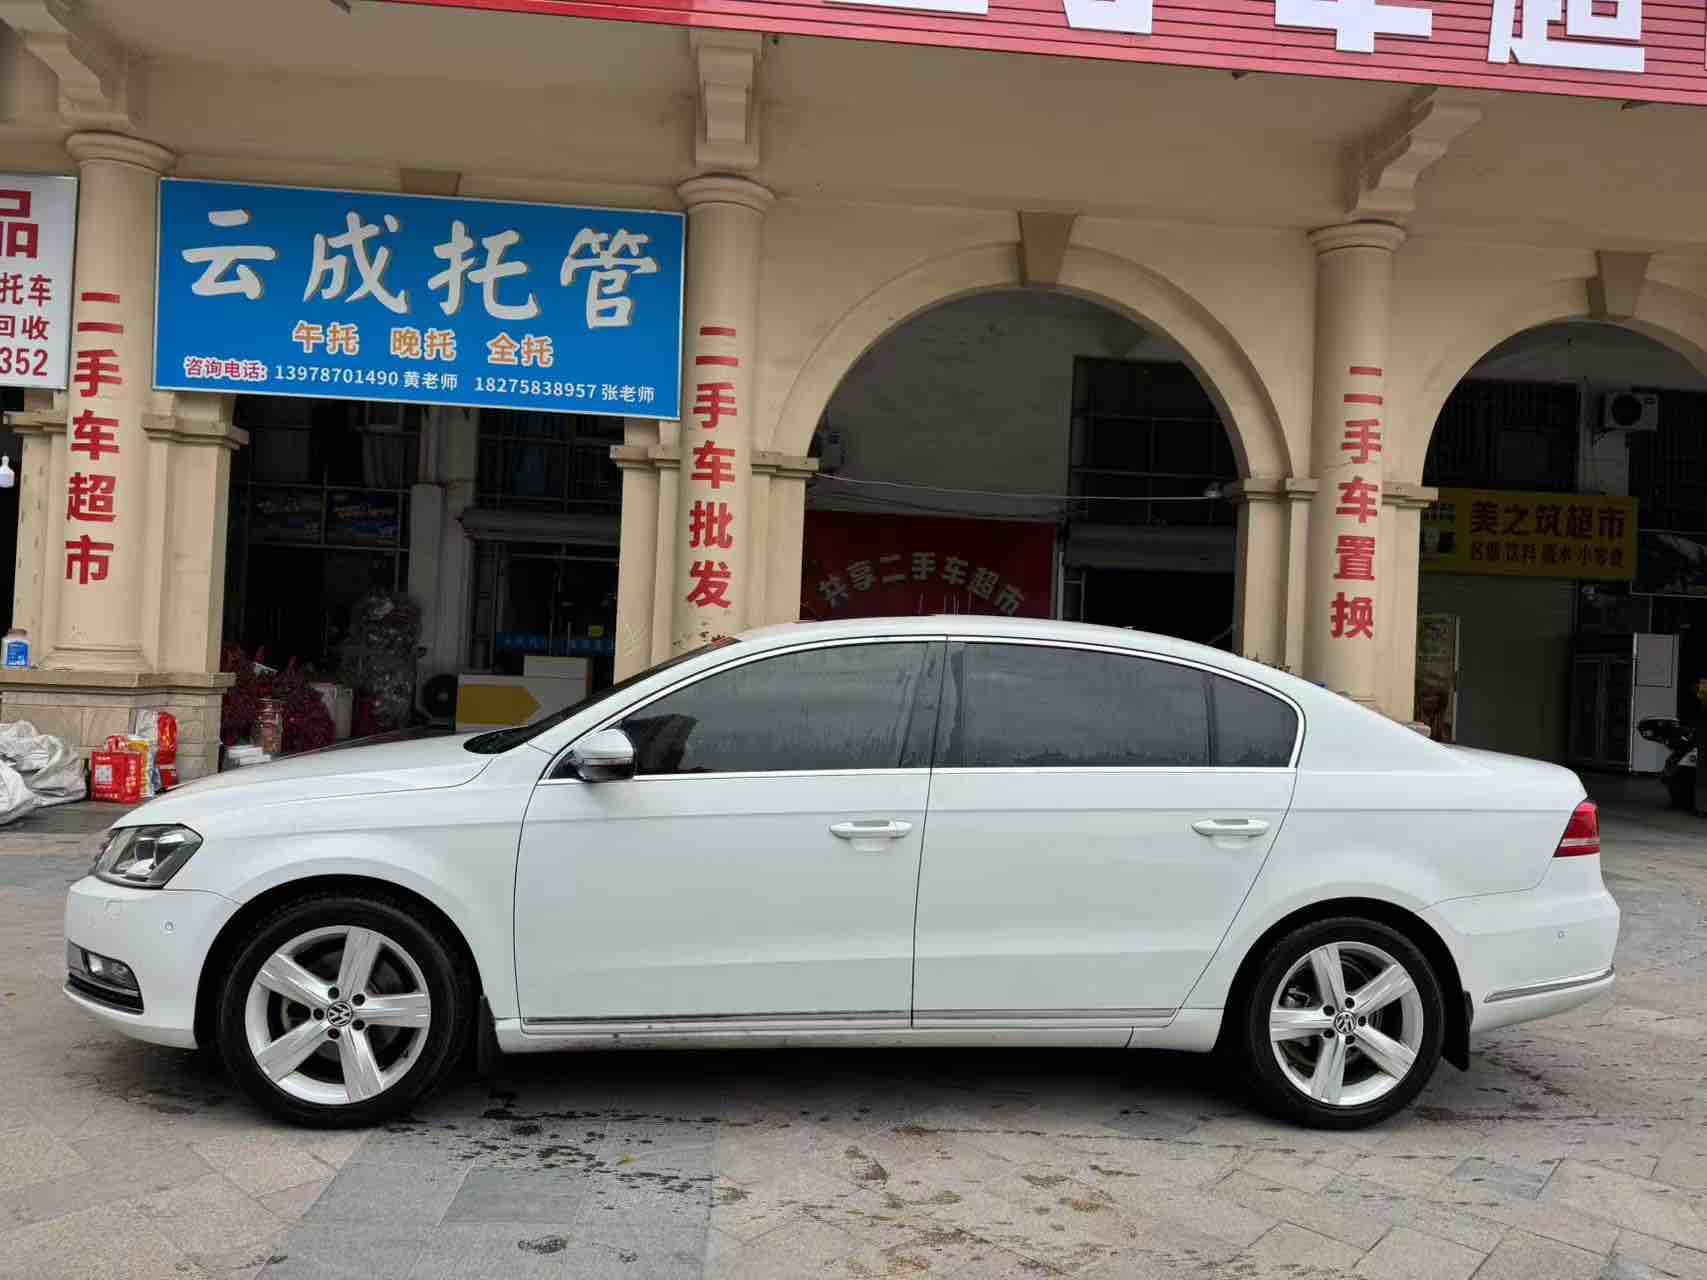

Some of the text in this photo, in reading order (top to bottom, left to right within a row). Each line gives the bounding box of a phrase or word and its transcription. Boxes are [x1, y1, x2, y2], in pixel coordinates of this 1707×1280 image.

[0, 272, 52, 307] 托车
[181, 208, 661, 329] 云成托管
[0, 314, 50, 341] 回收
[292, 320, 554, 368] 午托 晚托 全托
[0, 346, 49, 377] 352
[275, 364, 399, 386] 13978701490
[403, 370, 459, 392] 黄老师
[474, 377, 598, 400] 18275838957
[601, 383, 657, 404] 张老师
[65, 291, 124, 585] 二手车超市
[686, 325, 739, 609] 二手车批发
[1330, 366, 1384, 640] 二手车置换
